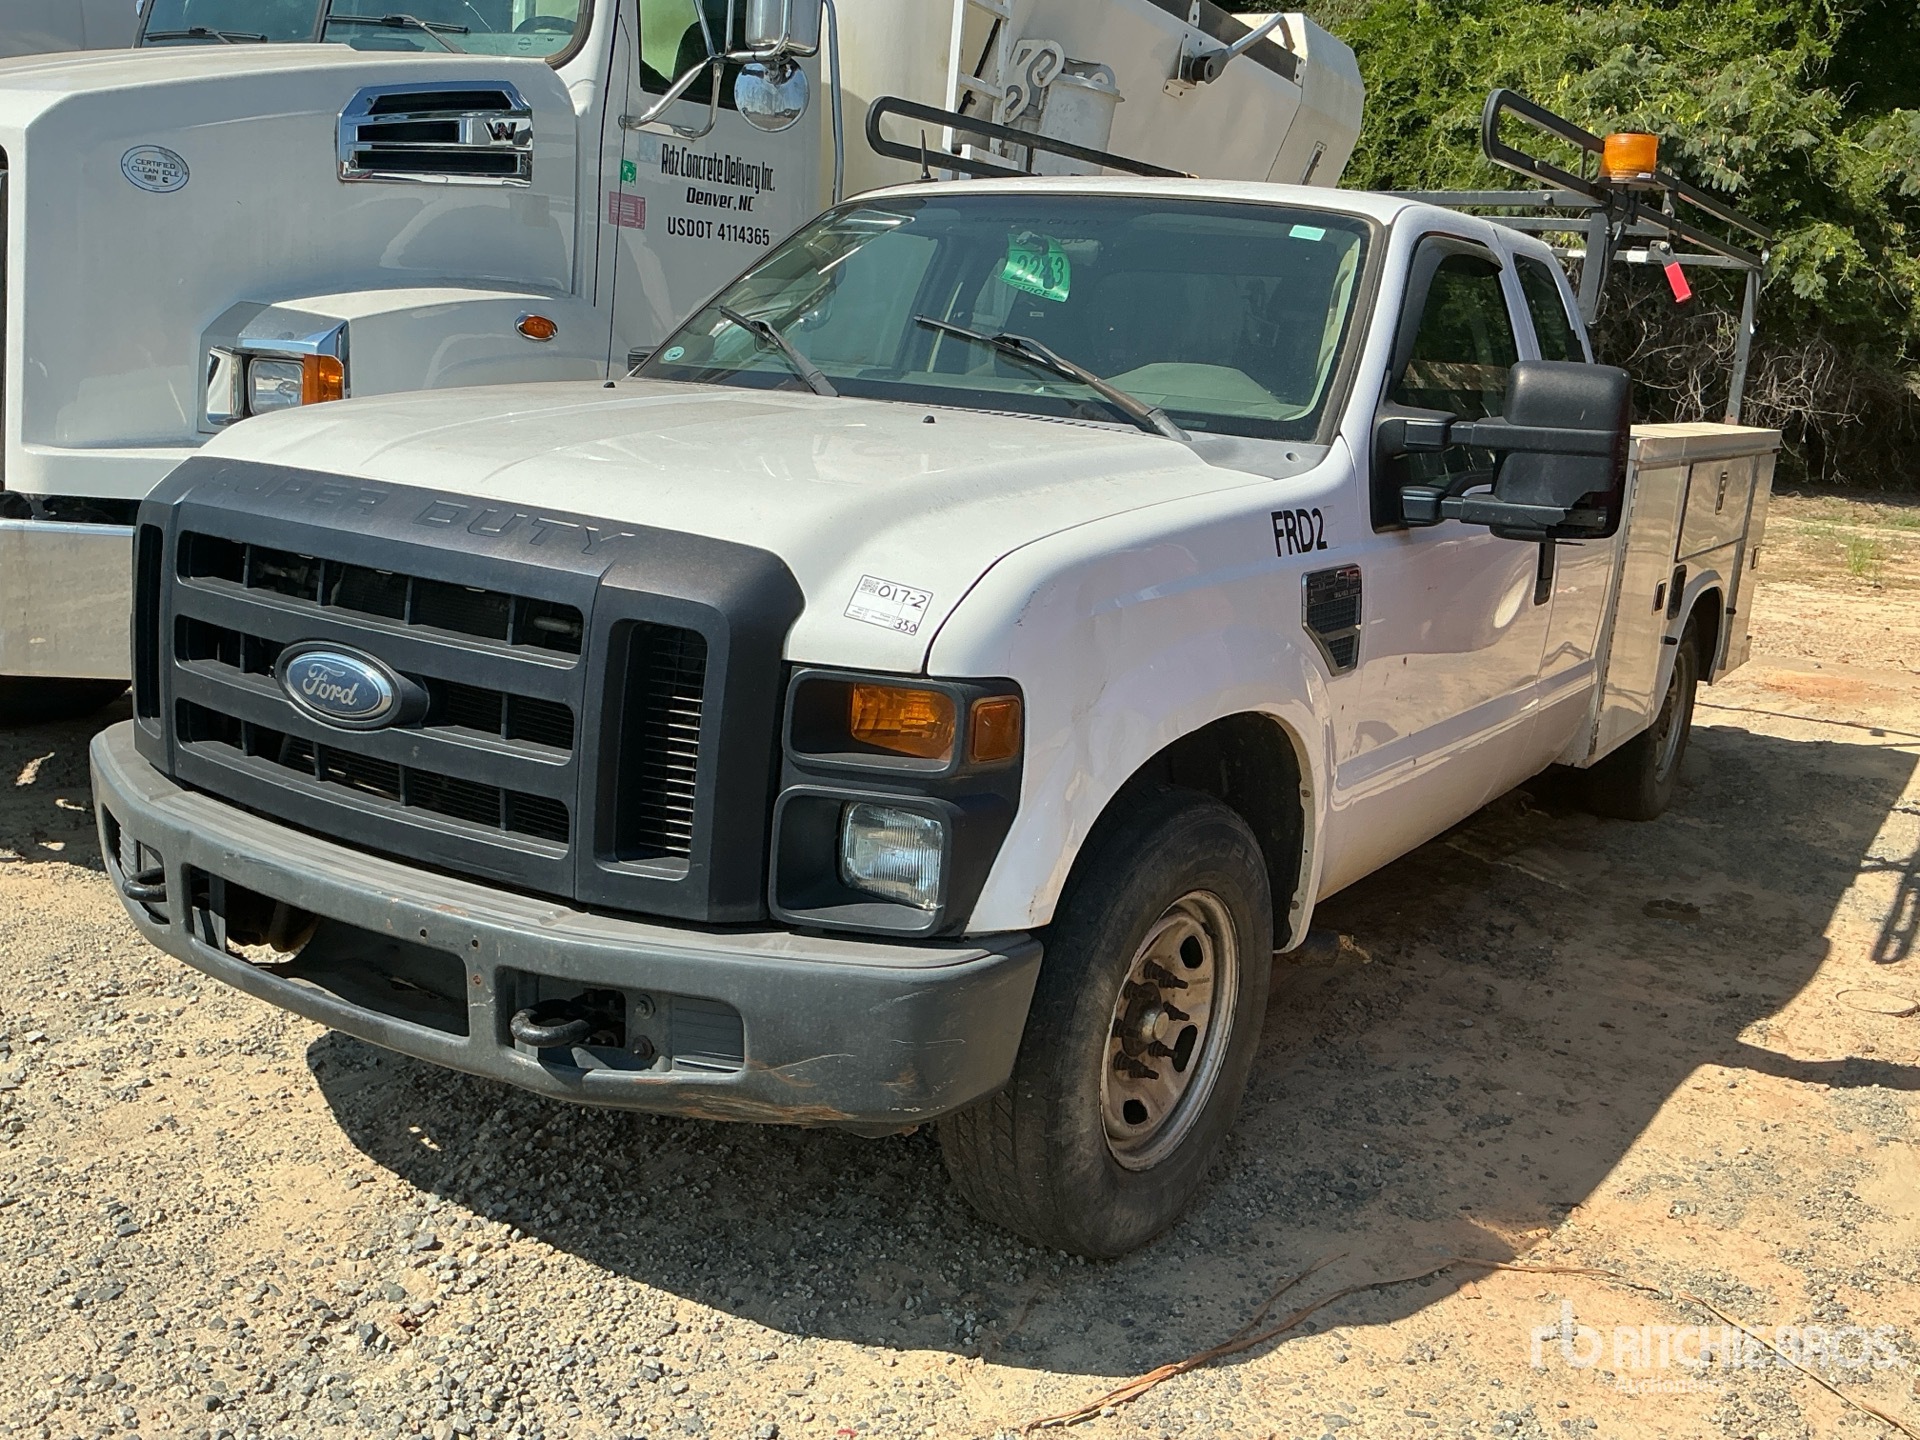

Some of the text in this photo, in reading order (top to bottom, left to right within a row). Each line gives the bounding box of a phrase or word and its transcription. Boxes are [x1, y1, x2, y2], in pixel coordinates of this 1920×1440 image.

[131, 165, 159, 175] CLEAN
[162, 169, 180, 178] IDLE
[135, 158, 176, 170] CERTIFIED
[661, 143, 680, 176] Rdz
[681, 147, 723, 183] Concrete
[724, 155, 760, 194] Delivery
[761, 162, 776, 191] Inc.
[738, 194, 755, 212] NC
[667, 216, 770, 246] USDOT 4114365
[203, 467, 636, 555] SUPER DUTY
[1270, 507, 1328, 557] FRD2
[877, 584, 927, 609] 017-2
[893, 618, 918, 634] 350
[302, 663, 360, 706] Ford
